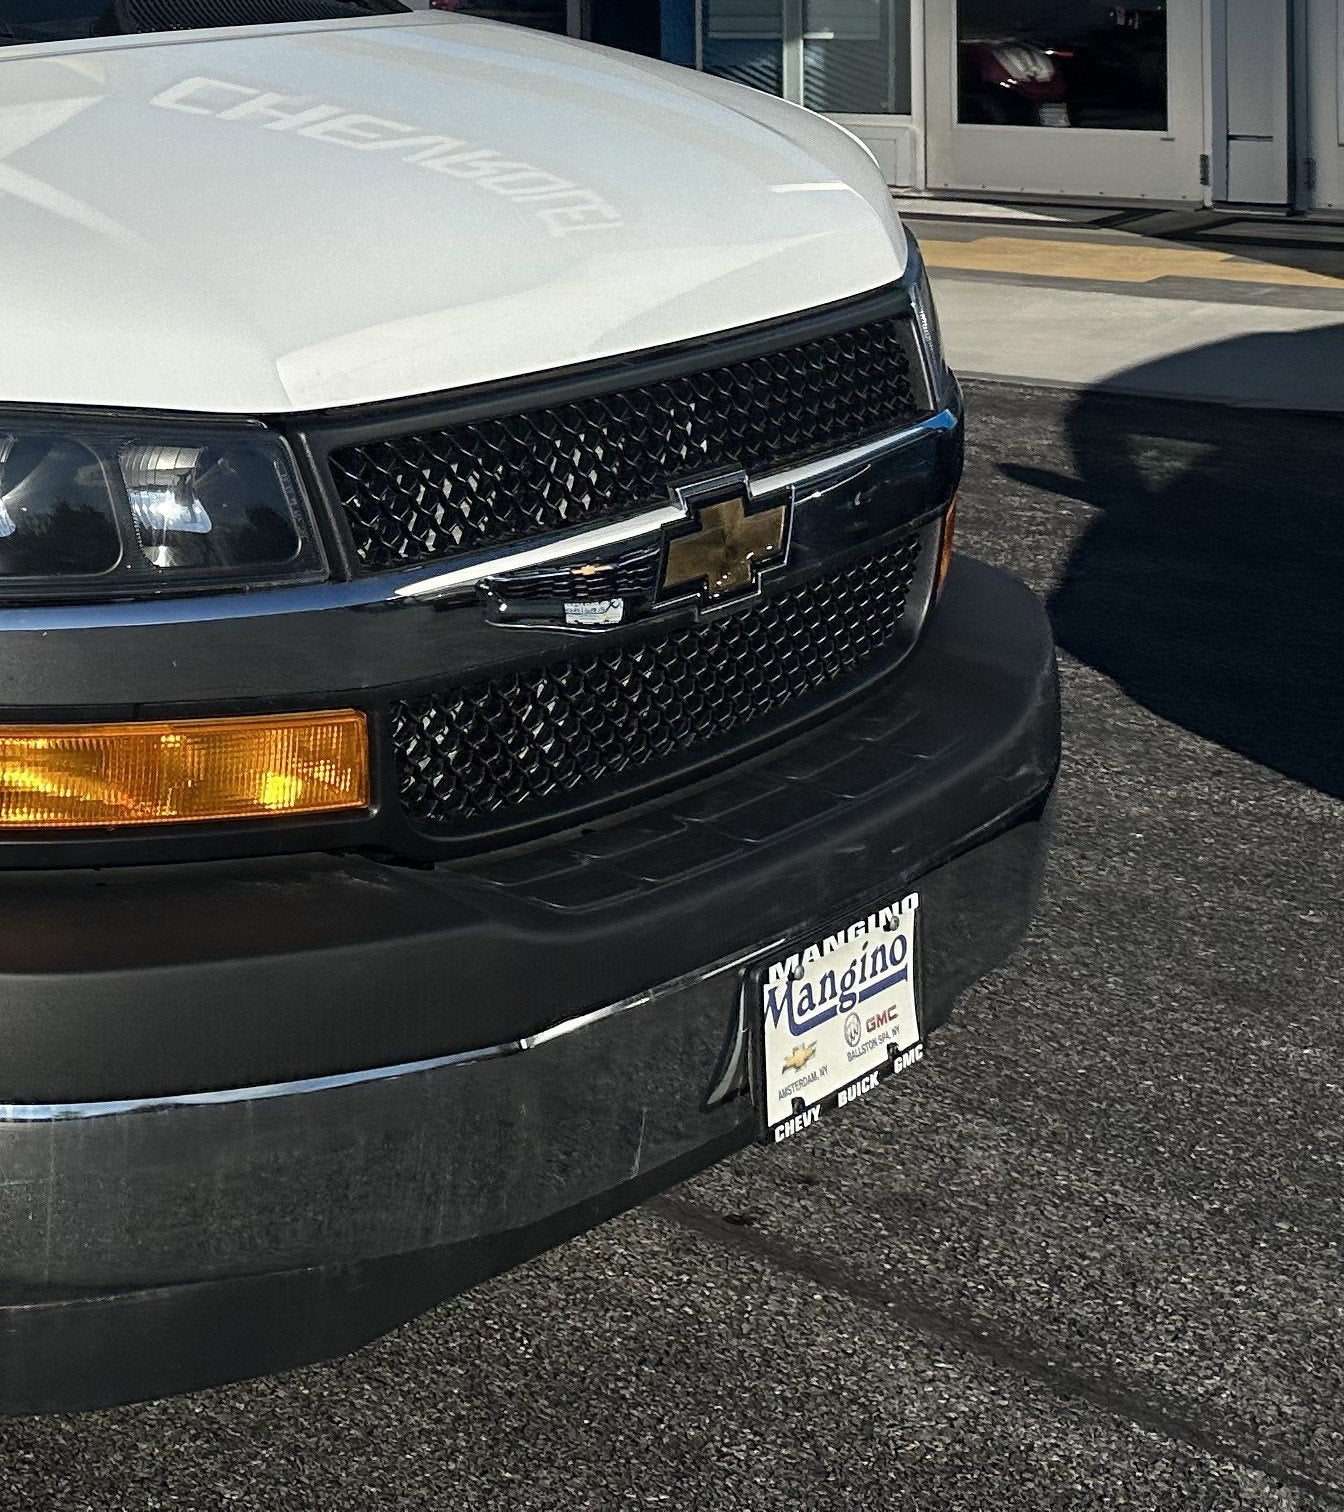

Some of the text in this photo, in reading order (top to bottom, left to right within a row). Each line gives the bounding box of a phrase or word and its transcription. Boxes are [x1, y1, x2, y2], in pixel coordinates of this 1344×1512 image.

[768, 892, 919, 984] MANGINO
[764, 934, 908, 1036] Mangino
[866, 1005, 899, 1033] GMC
[847, 1039, 878, 1062] BALLSTON
[774, 1044, 924, 1143] CHEVY BUICK GMC
[778, 1071, 820, 1100] AMSTERDAM,
